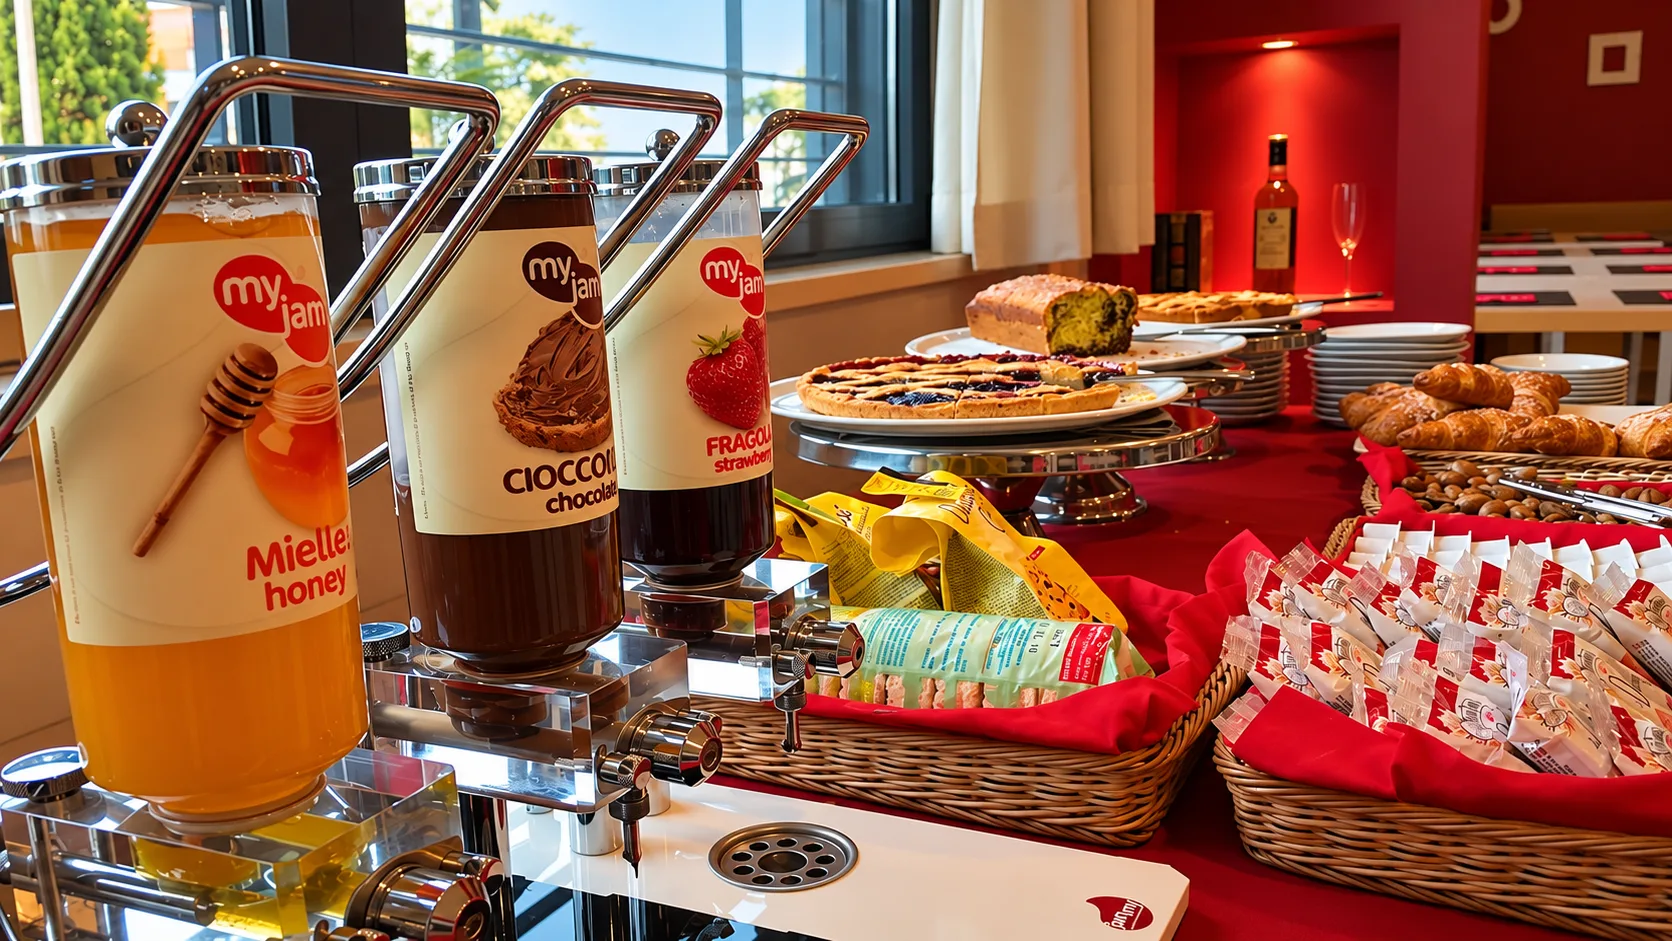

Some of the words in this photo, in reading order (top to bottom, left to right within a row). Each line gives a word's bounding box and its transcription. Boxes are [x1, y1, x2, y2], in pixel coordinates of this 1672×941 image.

[529, 256, 572, 286] my
[571, 271, 601, 307] jam
[705, 259, 740, 284] my
[738, 271, 763, 301] jam
[222, 274, 282, 311] my
[280, 294, 327, 339] jam
[264, 564, 346, 612] honey
